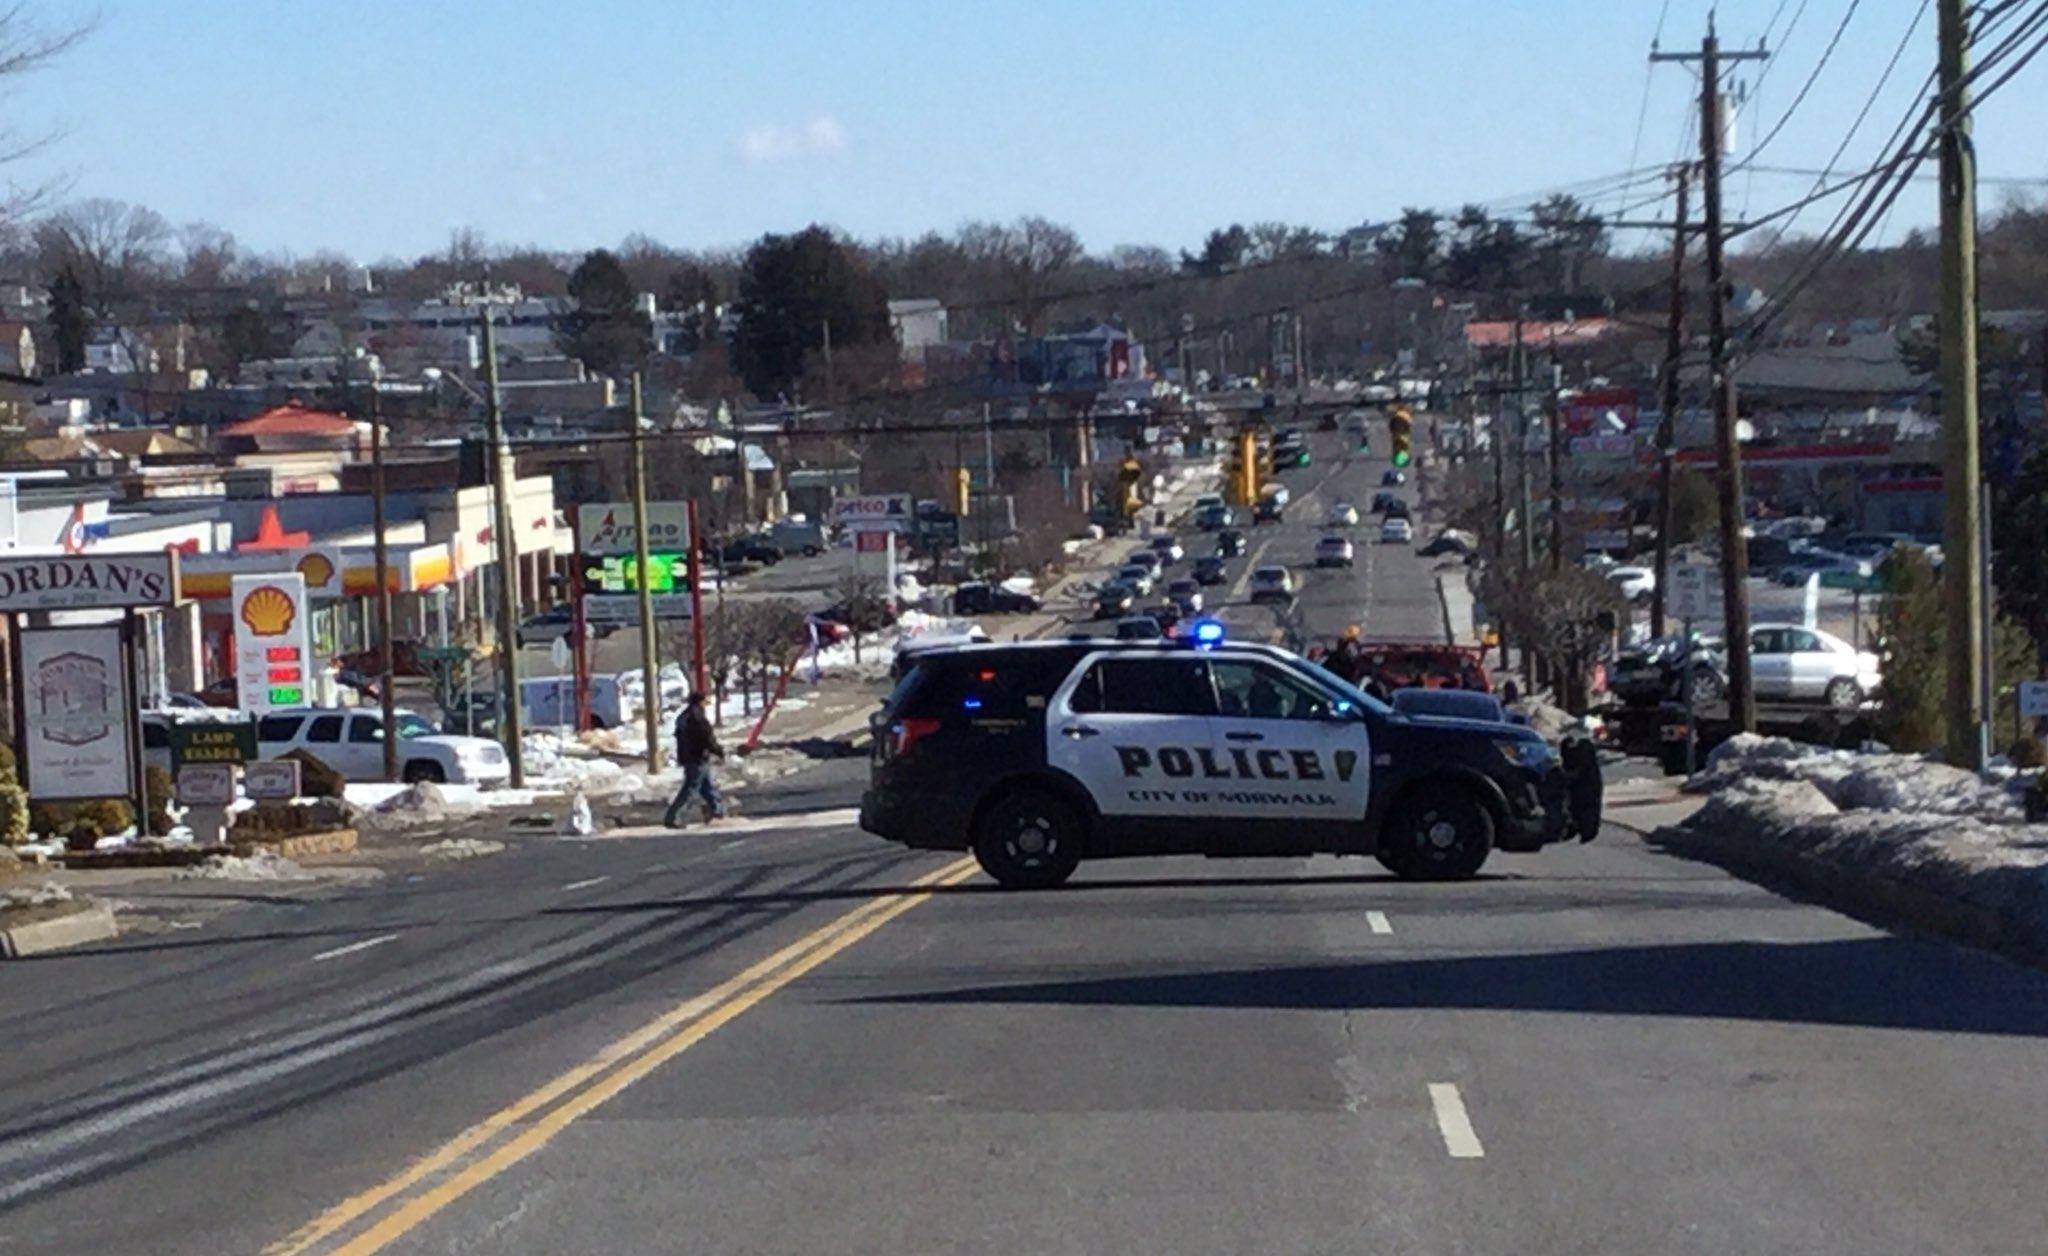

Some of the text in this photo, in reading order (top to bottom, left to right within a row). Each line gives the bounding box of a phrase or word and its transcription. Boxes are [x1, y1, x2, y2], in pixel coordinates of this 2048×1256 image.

[1113, 745, 1326, 781] POLICE
[1127, 790, 1336, 806] CITY OF NORWALK
